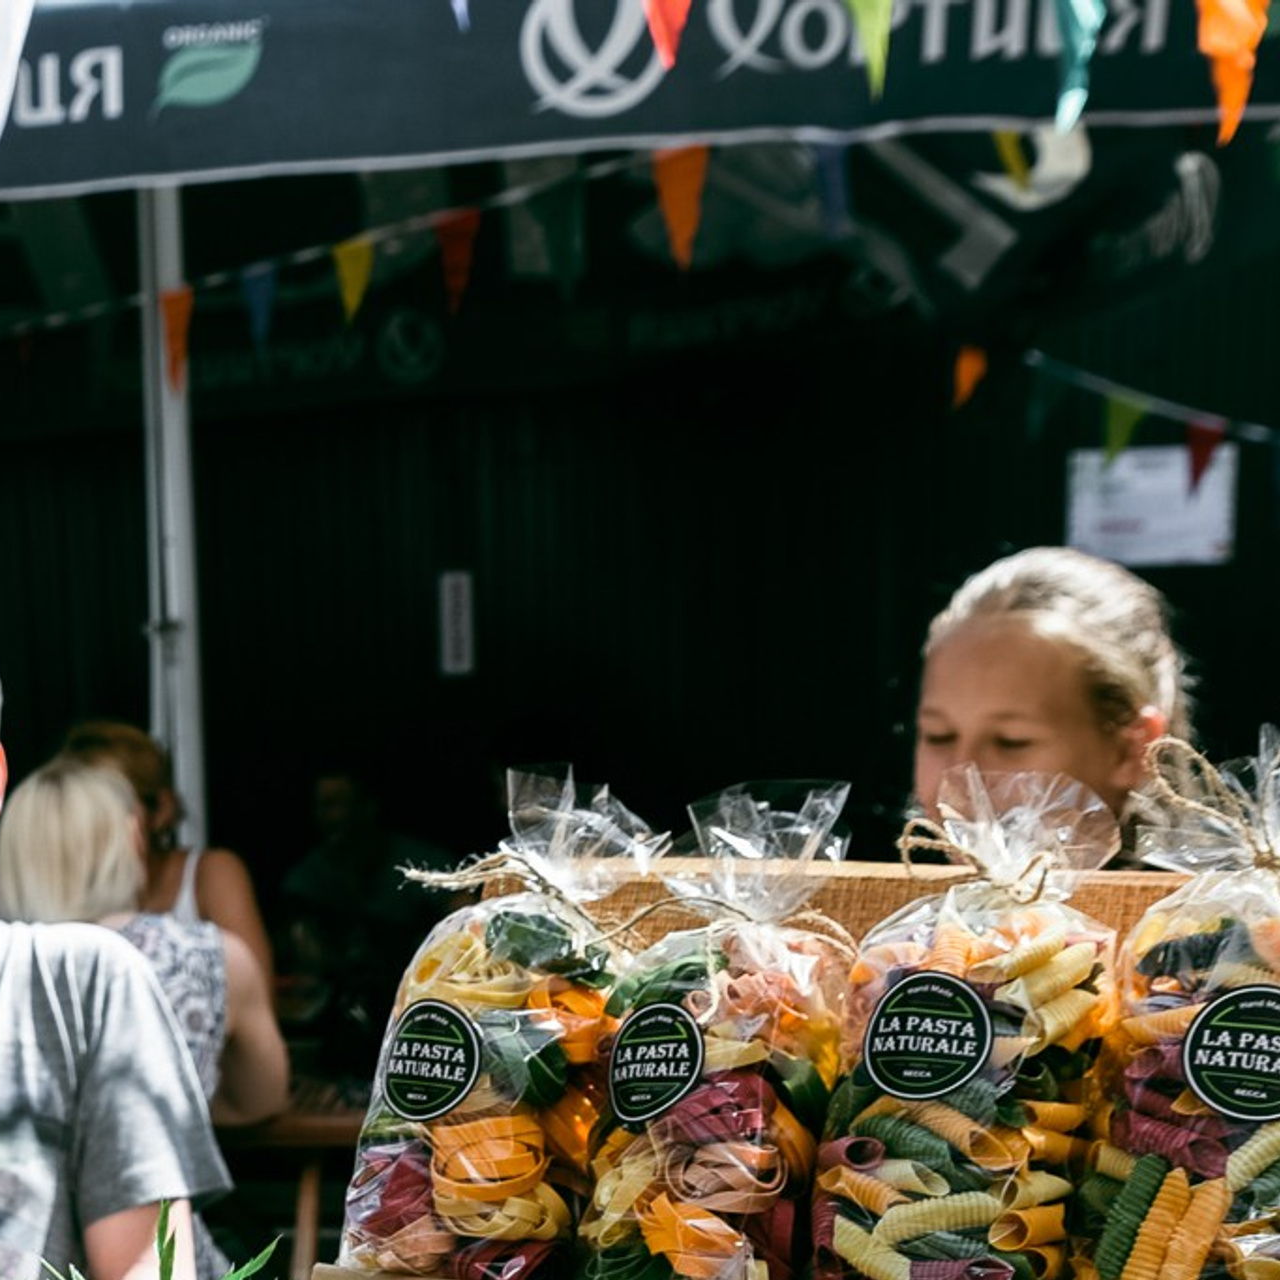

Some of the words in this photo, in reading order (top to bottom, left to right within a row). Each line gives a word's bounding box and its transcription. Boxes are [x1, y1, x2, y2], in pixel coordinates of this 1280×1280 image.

[878, 1017, 900, 1033] LA
[906, 1016, 976, 1037] PASTA
[872, 1035, 978, 1057] NATURALE
[1202, 1029, 1232, 1047] LA
[393, 1041, 408, 1055] LA
[412, 1042, 465, 1063] PASTA
[617, 1047, 632, 1064] LA
[636, 1043, 689, 1059] PASTA
[388, 1059, 466, 1082] NATURALE
[614, 1062, 691, 1081] NATURALE
